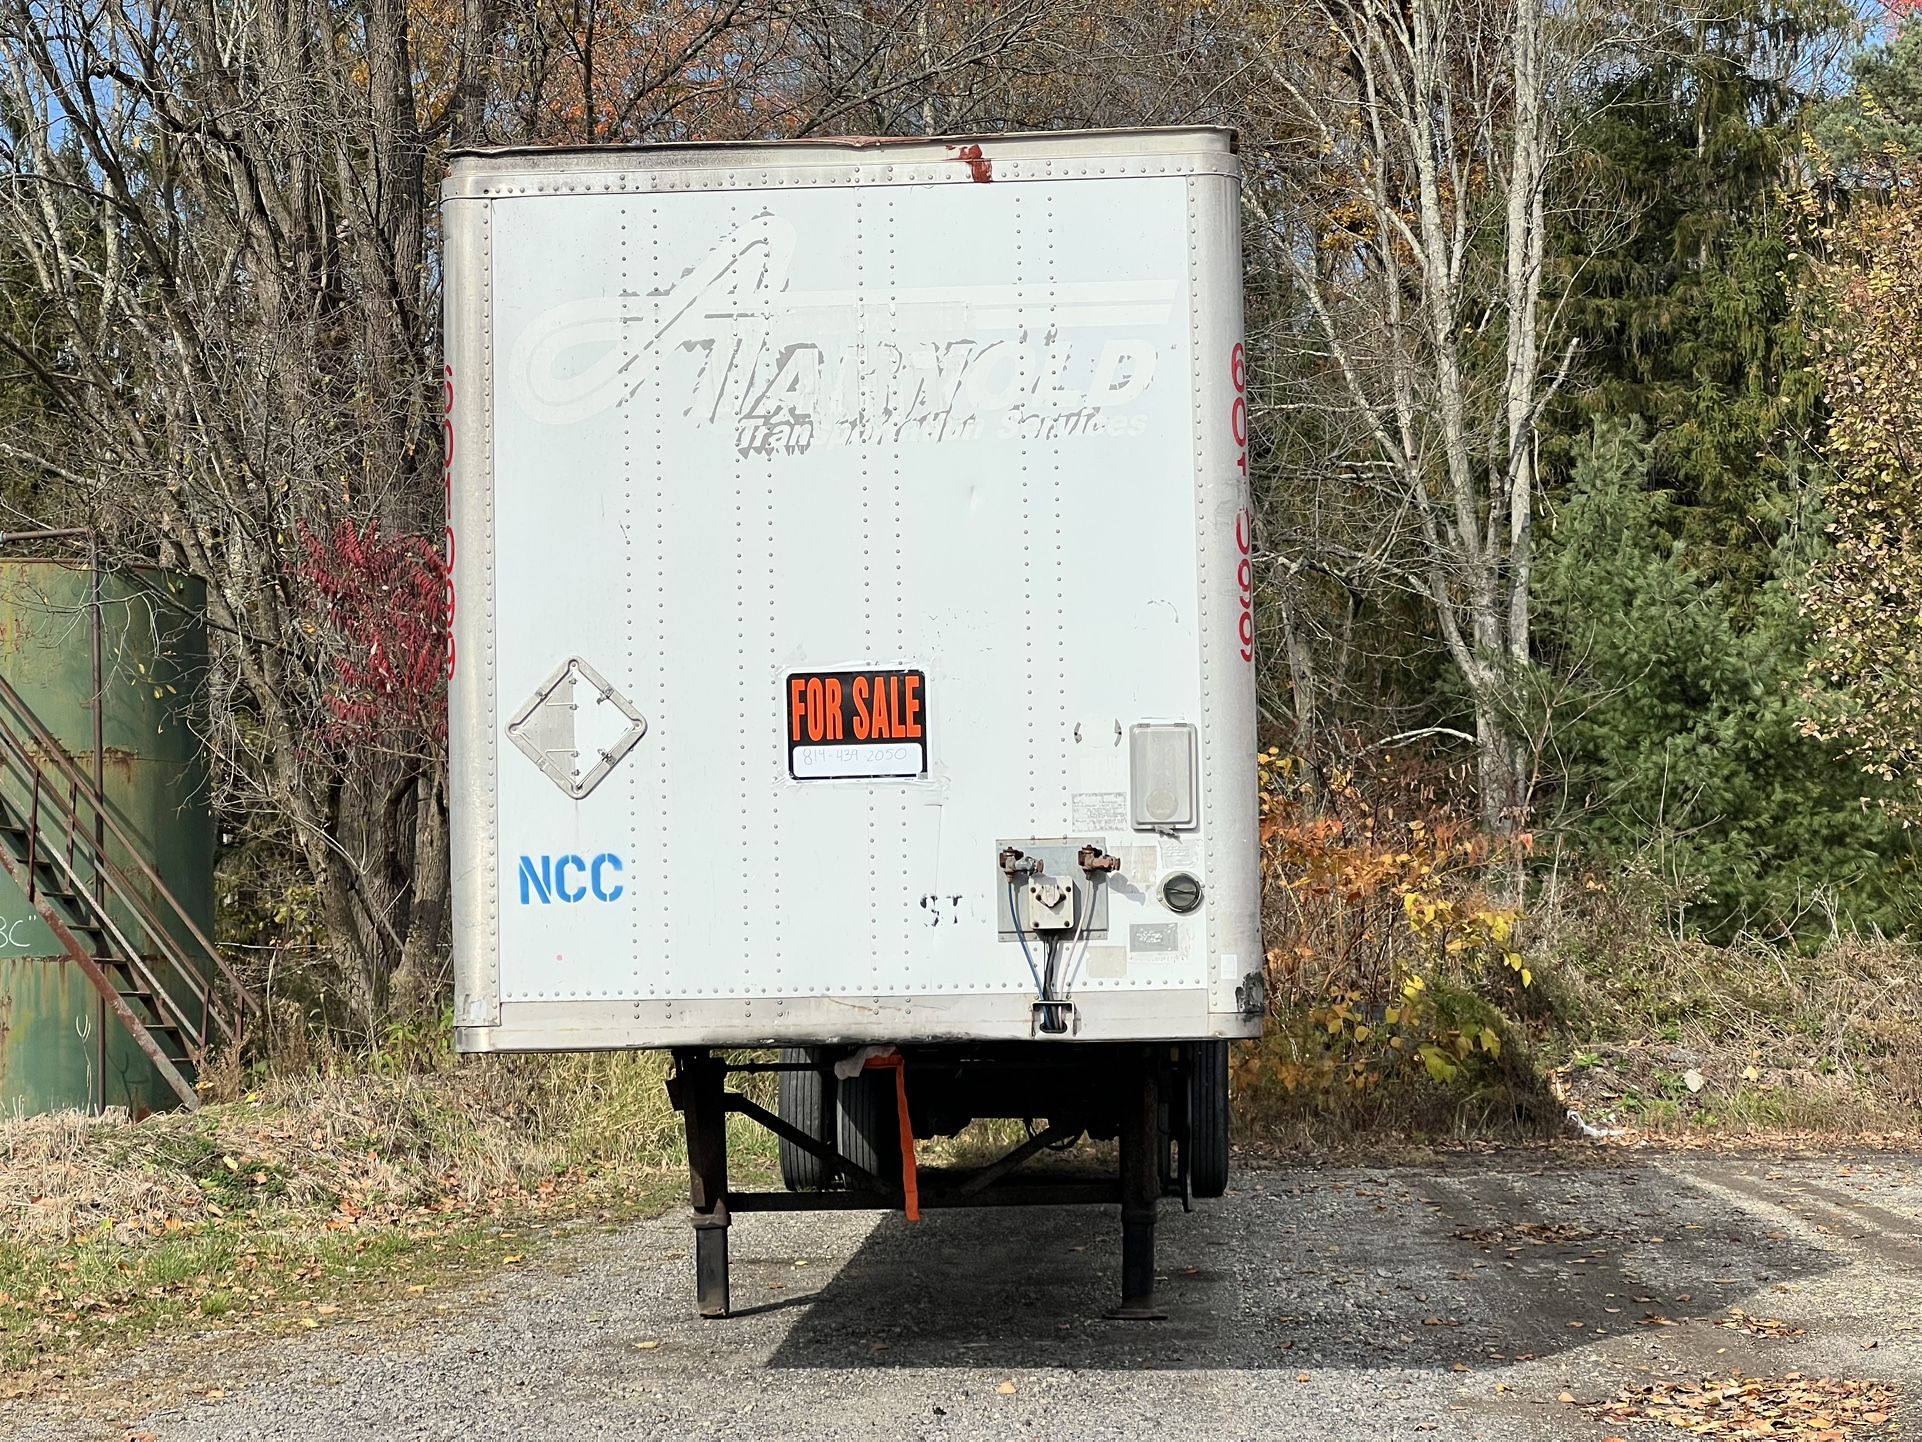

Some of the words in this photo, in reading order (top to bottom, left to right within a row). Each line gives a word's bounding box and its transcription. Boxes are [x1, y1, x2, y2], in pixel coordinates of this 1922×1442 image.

[791, 677, 844, 742] FOR
[852, 675, 922, 740] SALE
[519, 852, 624, 905] NCC
